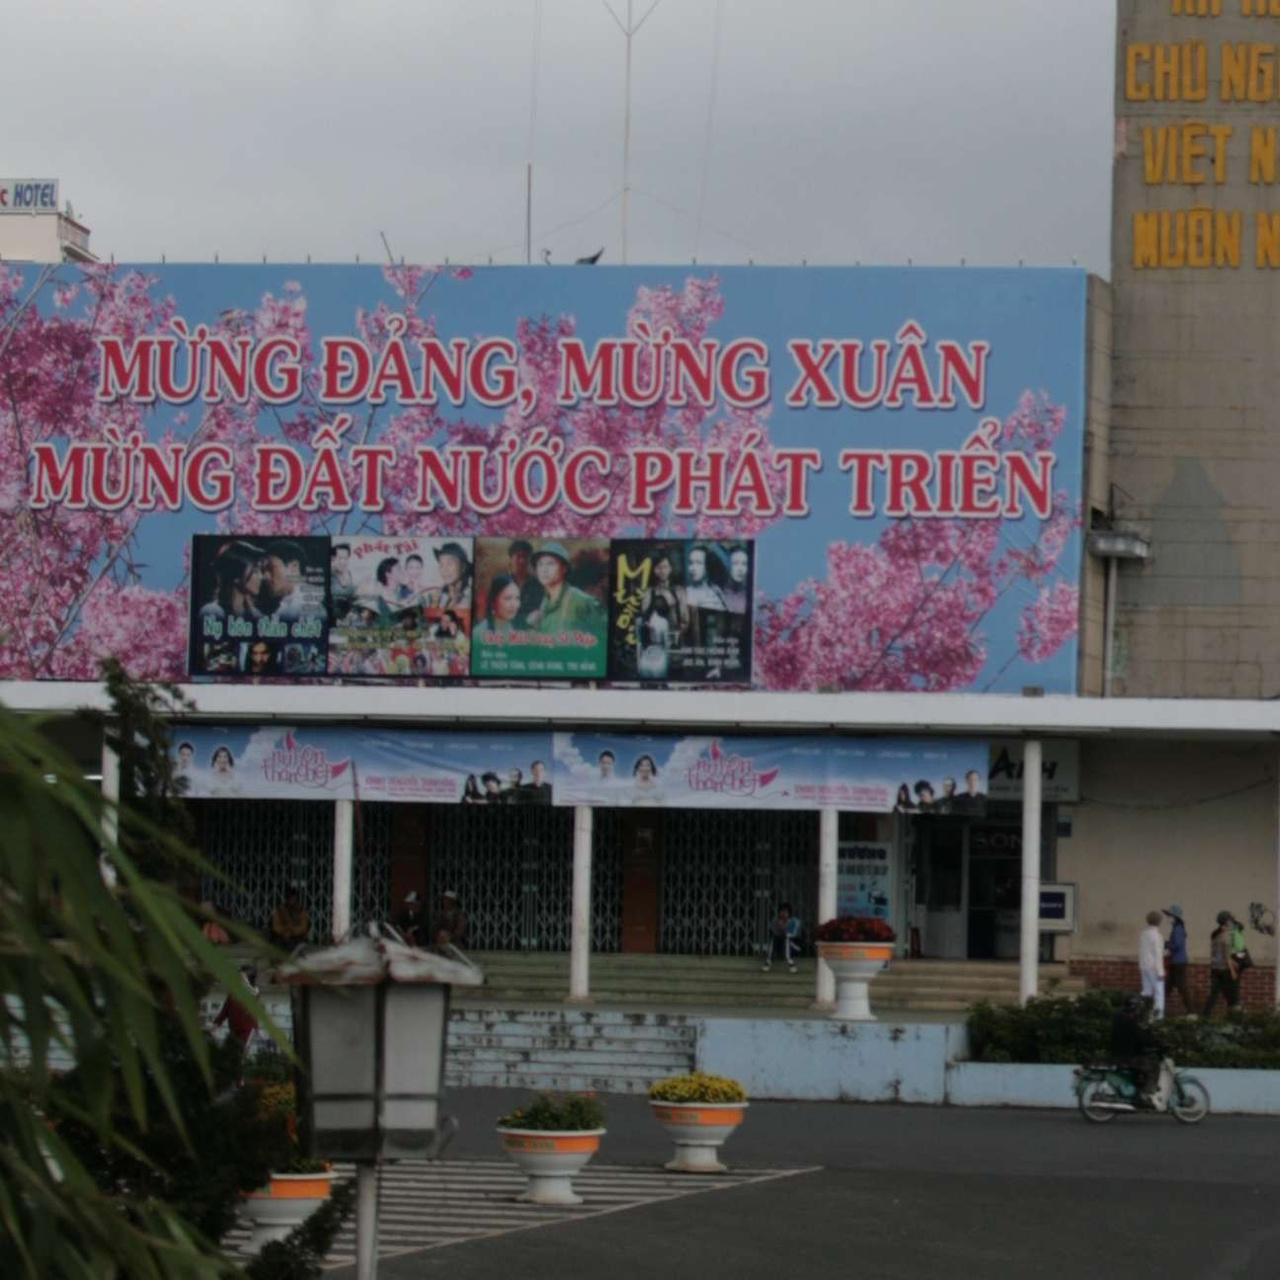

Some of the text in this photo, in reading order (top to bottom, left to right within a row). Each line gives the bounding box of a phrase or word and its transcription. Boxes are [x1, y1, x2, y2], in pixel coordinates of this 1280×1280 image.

[1142, 117, 1233, 187] VIỆT
[14, 183, 56, 207] HOTEL
[1133, 206, 1242, 269] MUÔN
[101, 316, 986, 412] MỪNG ĐẢNG, MỪNG XUÂN
[33, 417, 1053, 516] MỪNG ĐẤT NƯỚC PHÁT TRIỂN
